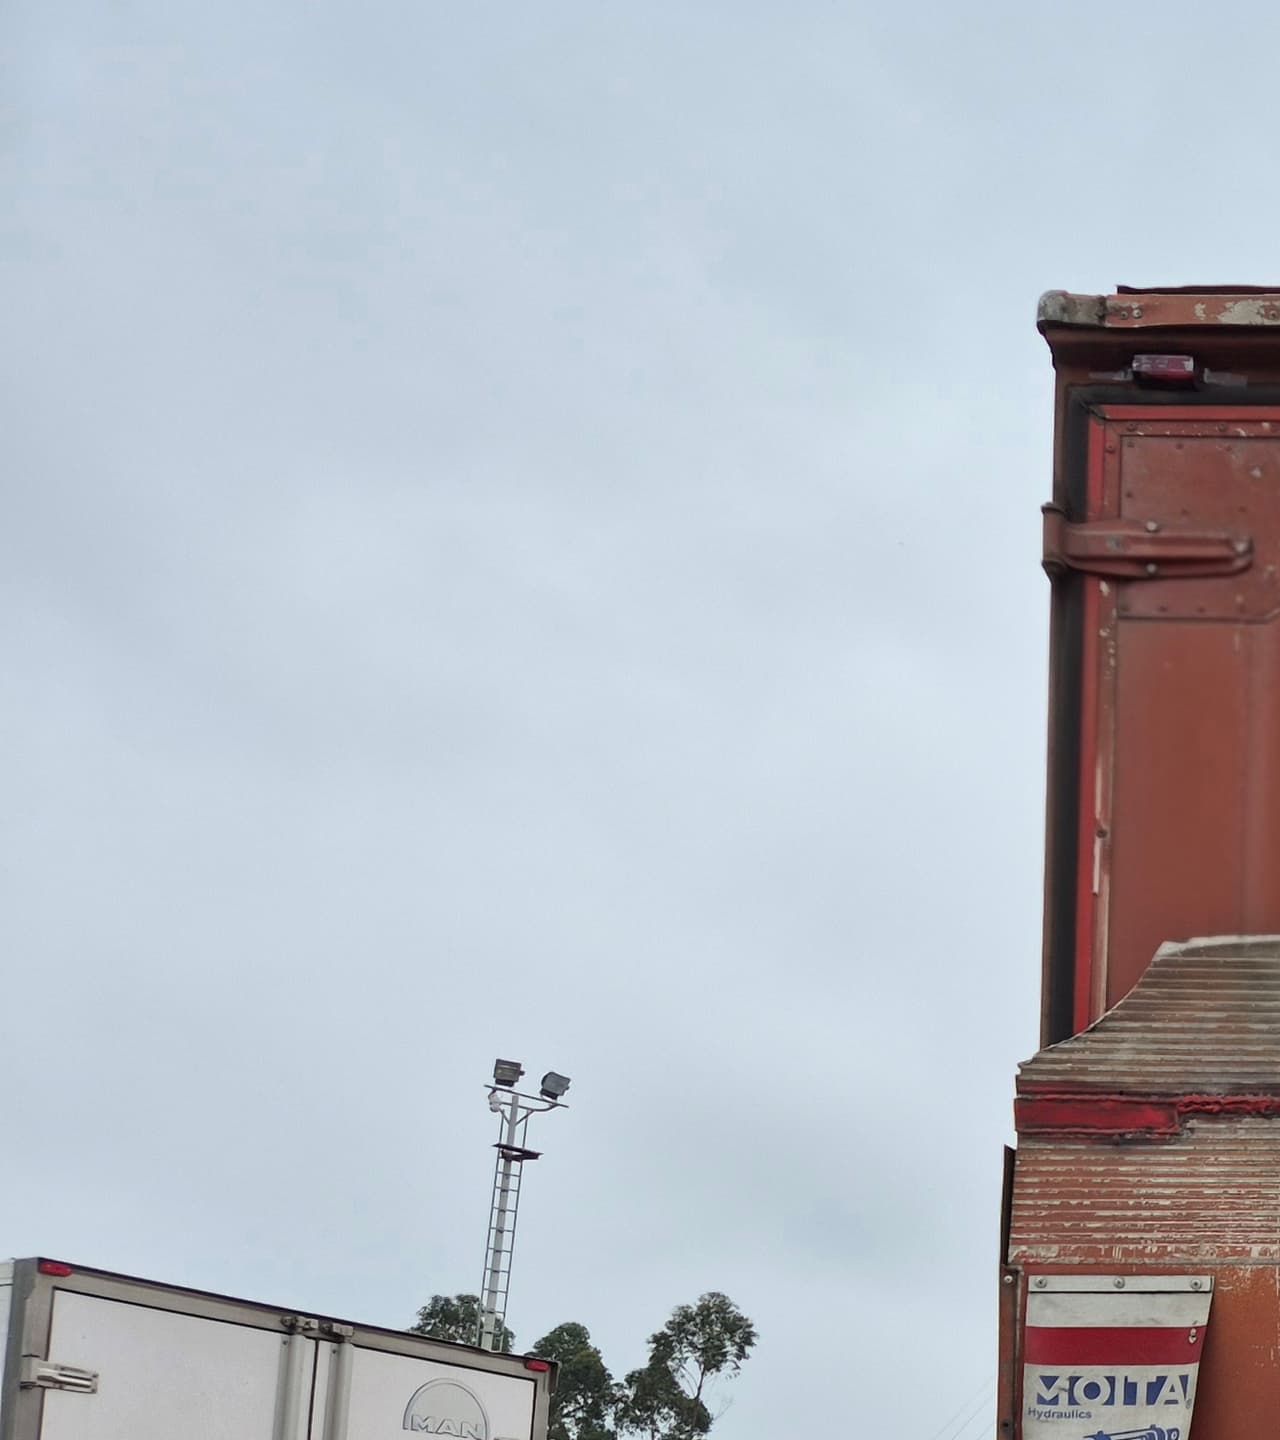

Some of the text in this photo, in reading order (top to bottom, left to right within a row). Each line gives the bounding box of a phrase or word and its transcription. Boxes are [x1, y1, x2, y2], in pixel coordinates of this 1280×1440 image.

[1036, 1375, 1190, 1406] MOITA
[1028, 1407, 1092, 1421] Hydraulics
[410, 1415, 483, 1440] MAN
